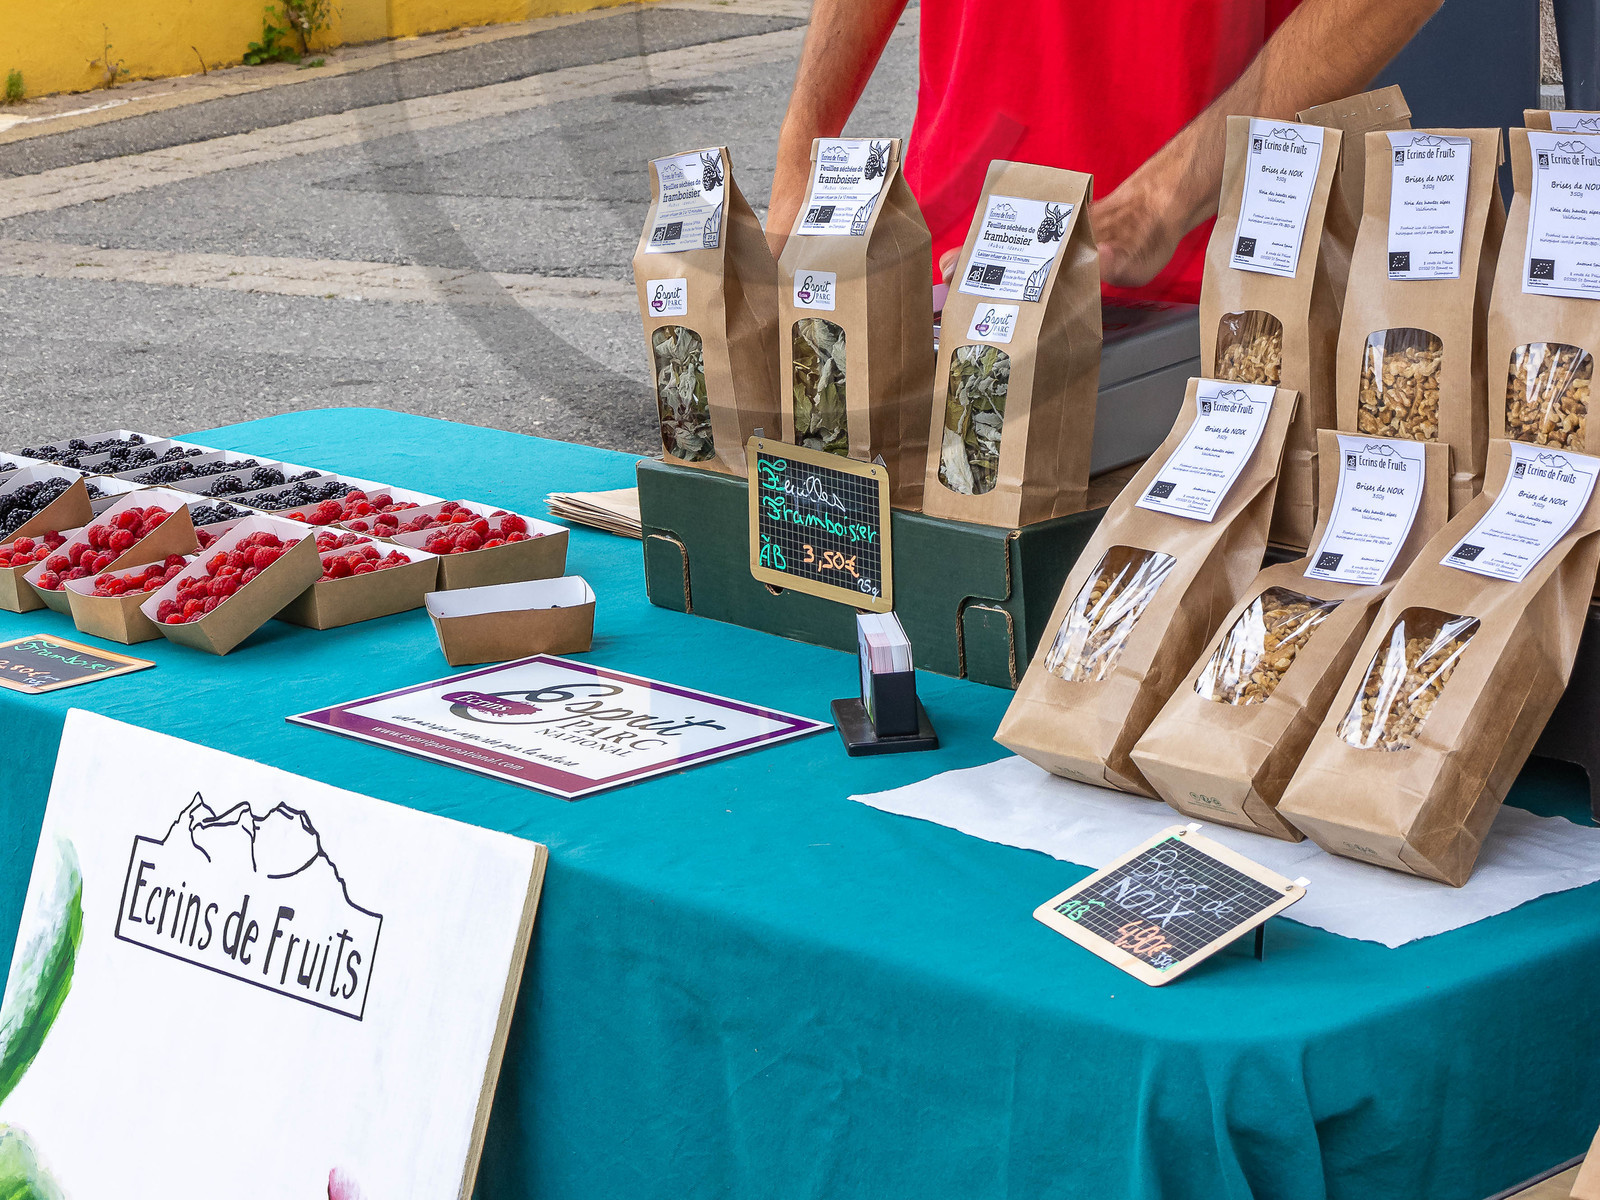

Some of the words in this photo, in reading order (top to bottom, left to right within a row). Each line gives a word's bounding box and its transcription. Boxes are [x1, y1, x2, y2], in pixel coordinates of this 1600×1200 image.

[1264, 139, 1282, 152] Ecrins
[1283, 142, 1289, 153] de
[1290, 142, 1307, 155] Fruits
[1406, 148, 1426, 160] Ecrins
[1426, 147, 1434, 159] de
[1435, 146, 1456, 159] Fruits
[1550, 153, 1571, 165] Ecrins
[1571, 155, 1580, 166] de
[818, 172, 861, 184] framboisier
[1261, 165, 1278, 175] Brises
[1288, 169, 1304, 178] NOIX
[1404, 175, 1424, 184] Brises
[1425, 174, 1434, 182] de
[1435, 173, 1455, 182] NOIX
[1551, 181, 1572, 190] Brises
[1573, 181, 1583, 190] de
[662, 188, 701, 203] framboisier
[986, 220, 1006, 230] Feuilles
[983, 229, 1033, 246] framboisier
[1358, 455, 1378, 468] Ecrins
[1378, 458, 1386, 469] de
[1387, 458, 1407, 472] Fruits
[1527, 463, 1547, 478] Ecrins
[1547, 468, 1556, 480] de
[1556, 469, 1577, 484] Fruits
[1355, 482, 1375, 492] Brises
[1376, 484, 1385, 493] de
[1386, 486, 1405, 496] NOIX
[1517, 490, 1537, 501] Brises
[1538, 494, 1548, 502] de
[1548, 497, 1569, 507] NOIX
[803, 544, 860, 578] 3,50€
[857, 577, 880, 604] 25g
[453, 694, 512, 712] Ecrins
[535, 728, 635, 759] NATIONAL
[557, 719, 670, 751] PARC
[371, 726, 525, 772] www.espritparcnational.com
[1100, 876, 1196, 929] NOIX
[128, 859, 219, 951] Ecrins
[223, 894, 260, 966] de
[262, 905, 363, 1000] Fruits
